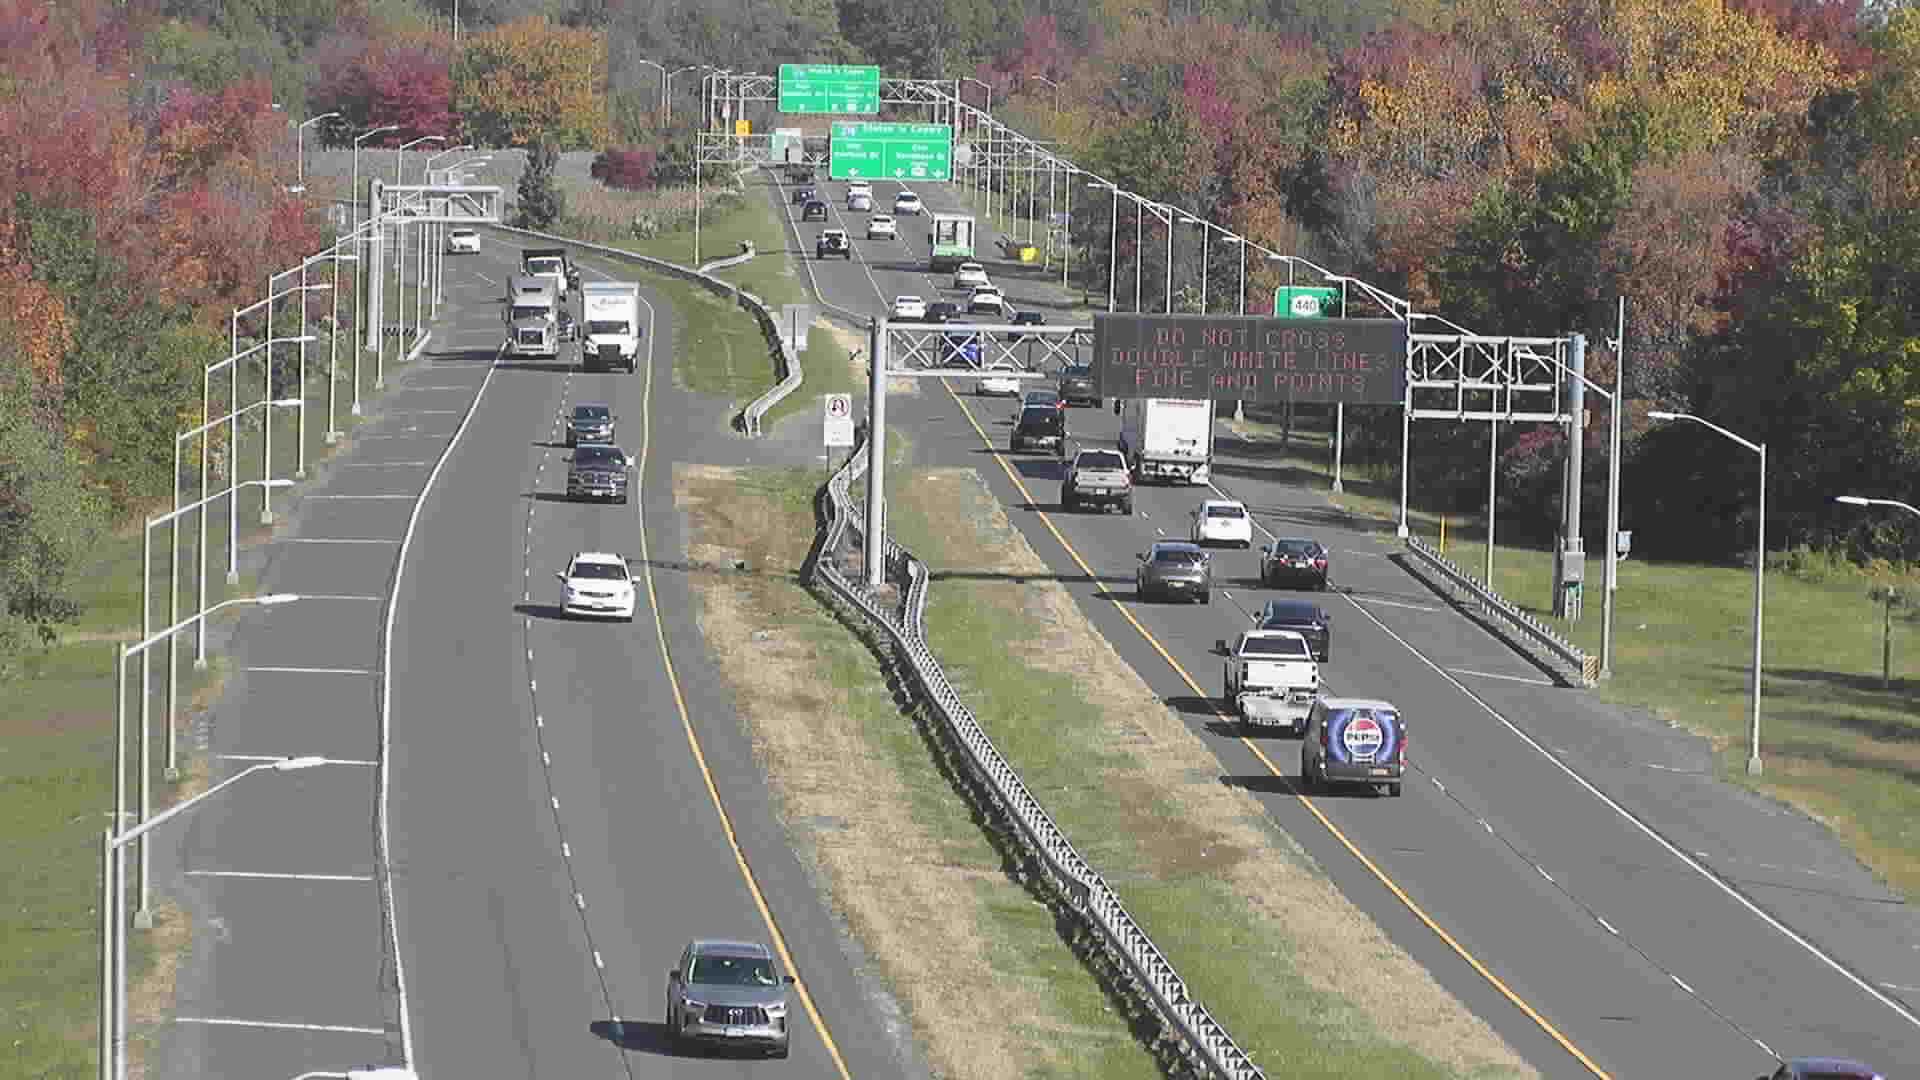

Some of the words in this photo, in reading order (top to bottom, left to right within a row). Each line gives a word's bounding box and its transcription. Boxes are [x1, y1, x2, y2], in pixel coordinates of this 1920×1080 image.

[1294, 299, 1319, 312] 440
[1154, 328, 1185, 345] DO
[1201, 328, 1248, 346] NOT
[1265, 328, 1345, 349] CROSS
[1111, 345, 1206, 367] DOUBLE
[1223, 349, 1297, 369] WHITE
[1313, 350, 1387, 373] LINES
[1135, 368, 1193, 388] FINE
[1211, 370, 1256, 389] AND
[1273, 372, 1366, 393] POINTS
